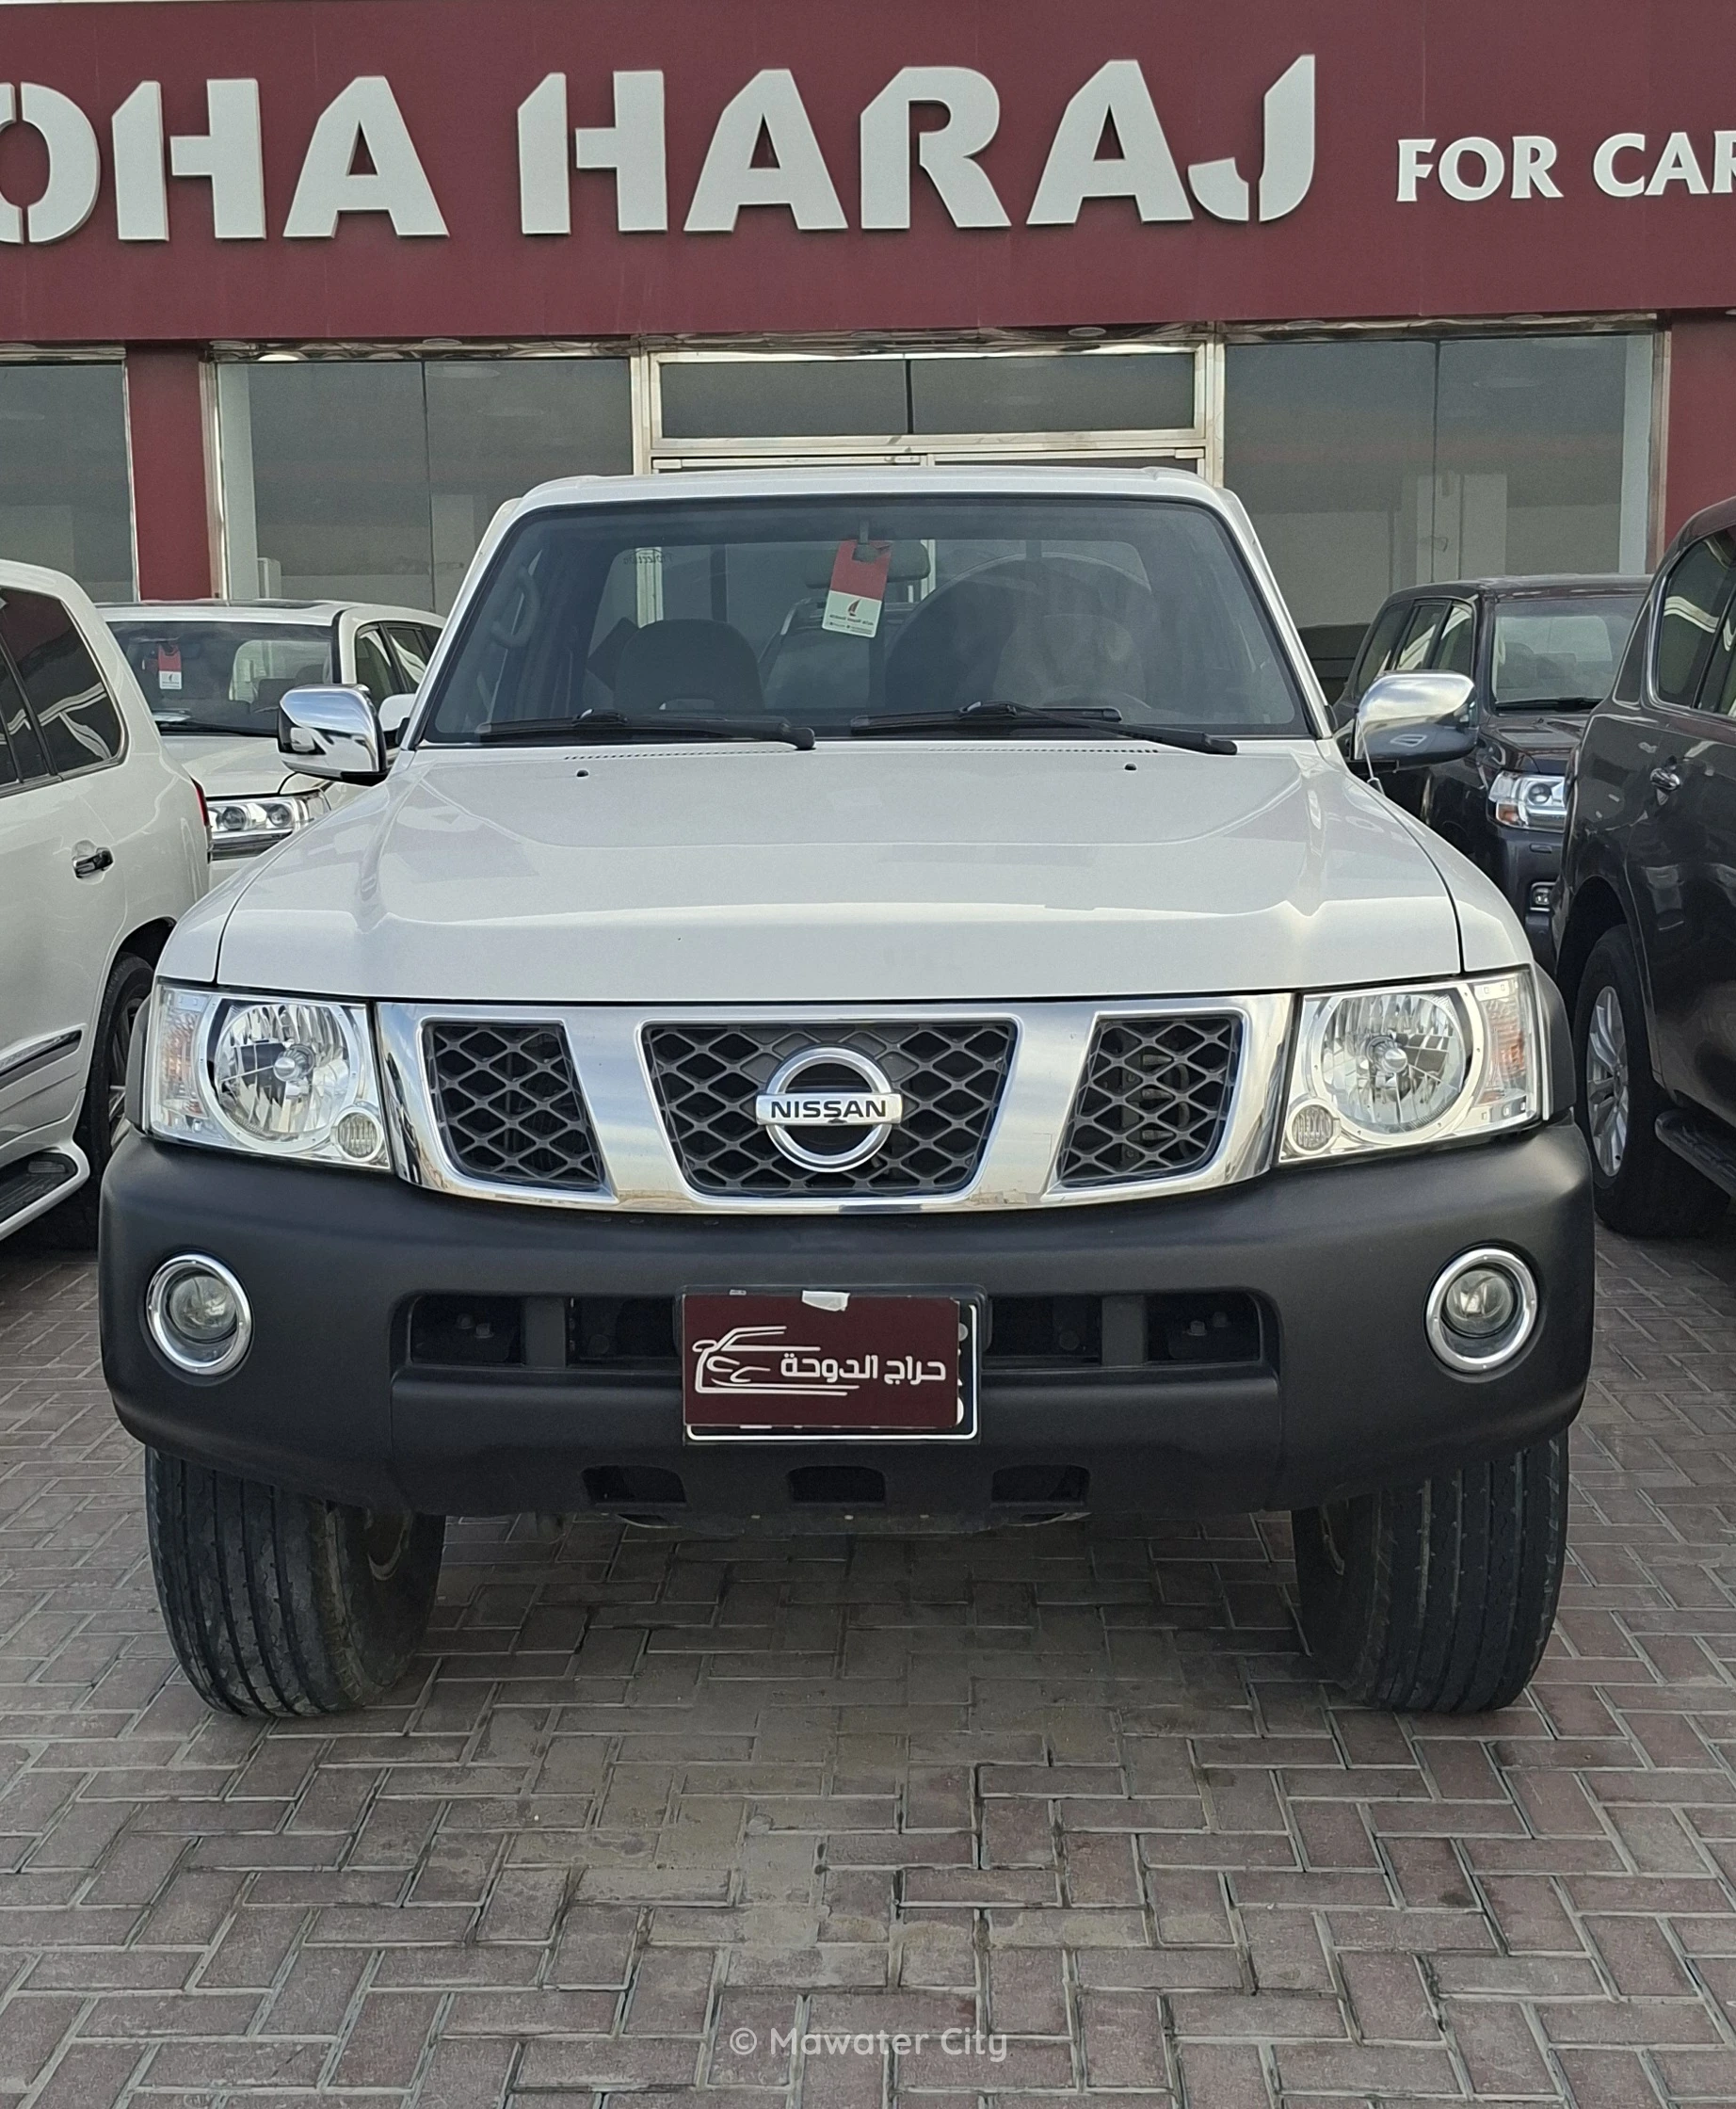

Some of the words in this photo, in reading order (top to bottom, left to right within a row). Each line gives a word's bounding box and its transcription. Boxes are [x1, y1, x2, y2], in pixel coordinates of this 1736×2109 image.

[517, 54, 1316, 234] HARAJ
[1396, 135, 1565, 202] FOR
[771, 1100, 887, 1119] NISSAN
[780, 1353, 879, 1383] الدوحة
[883, 1355, 947, 1385] حراج
